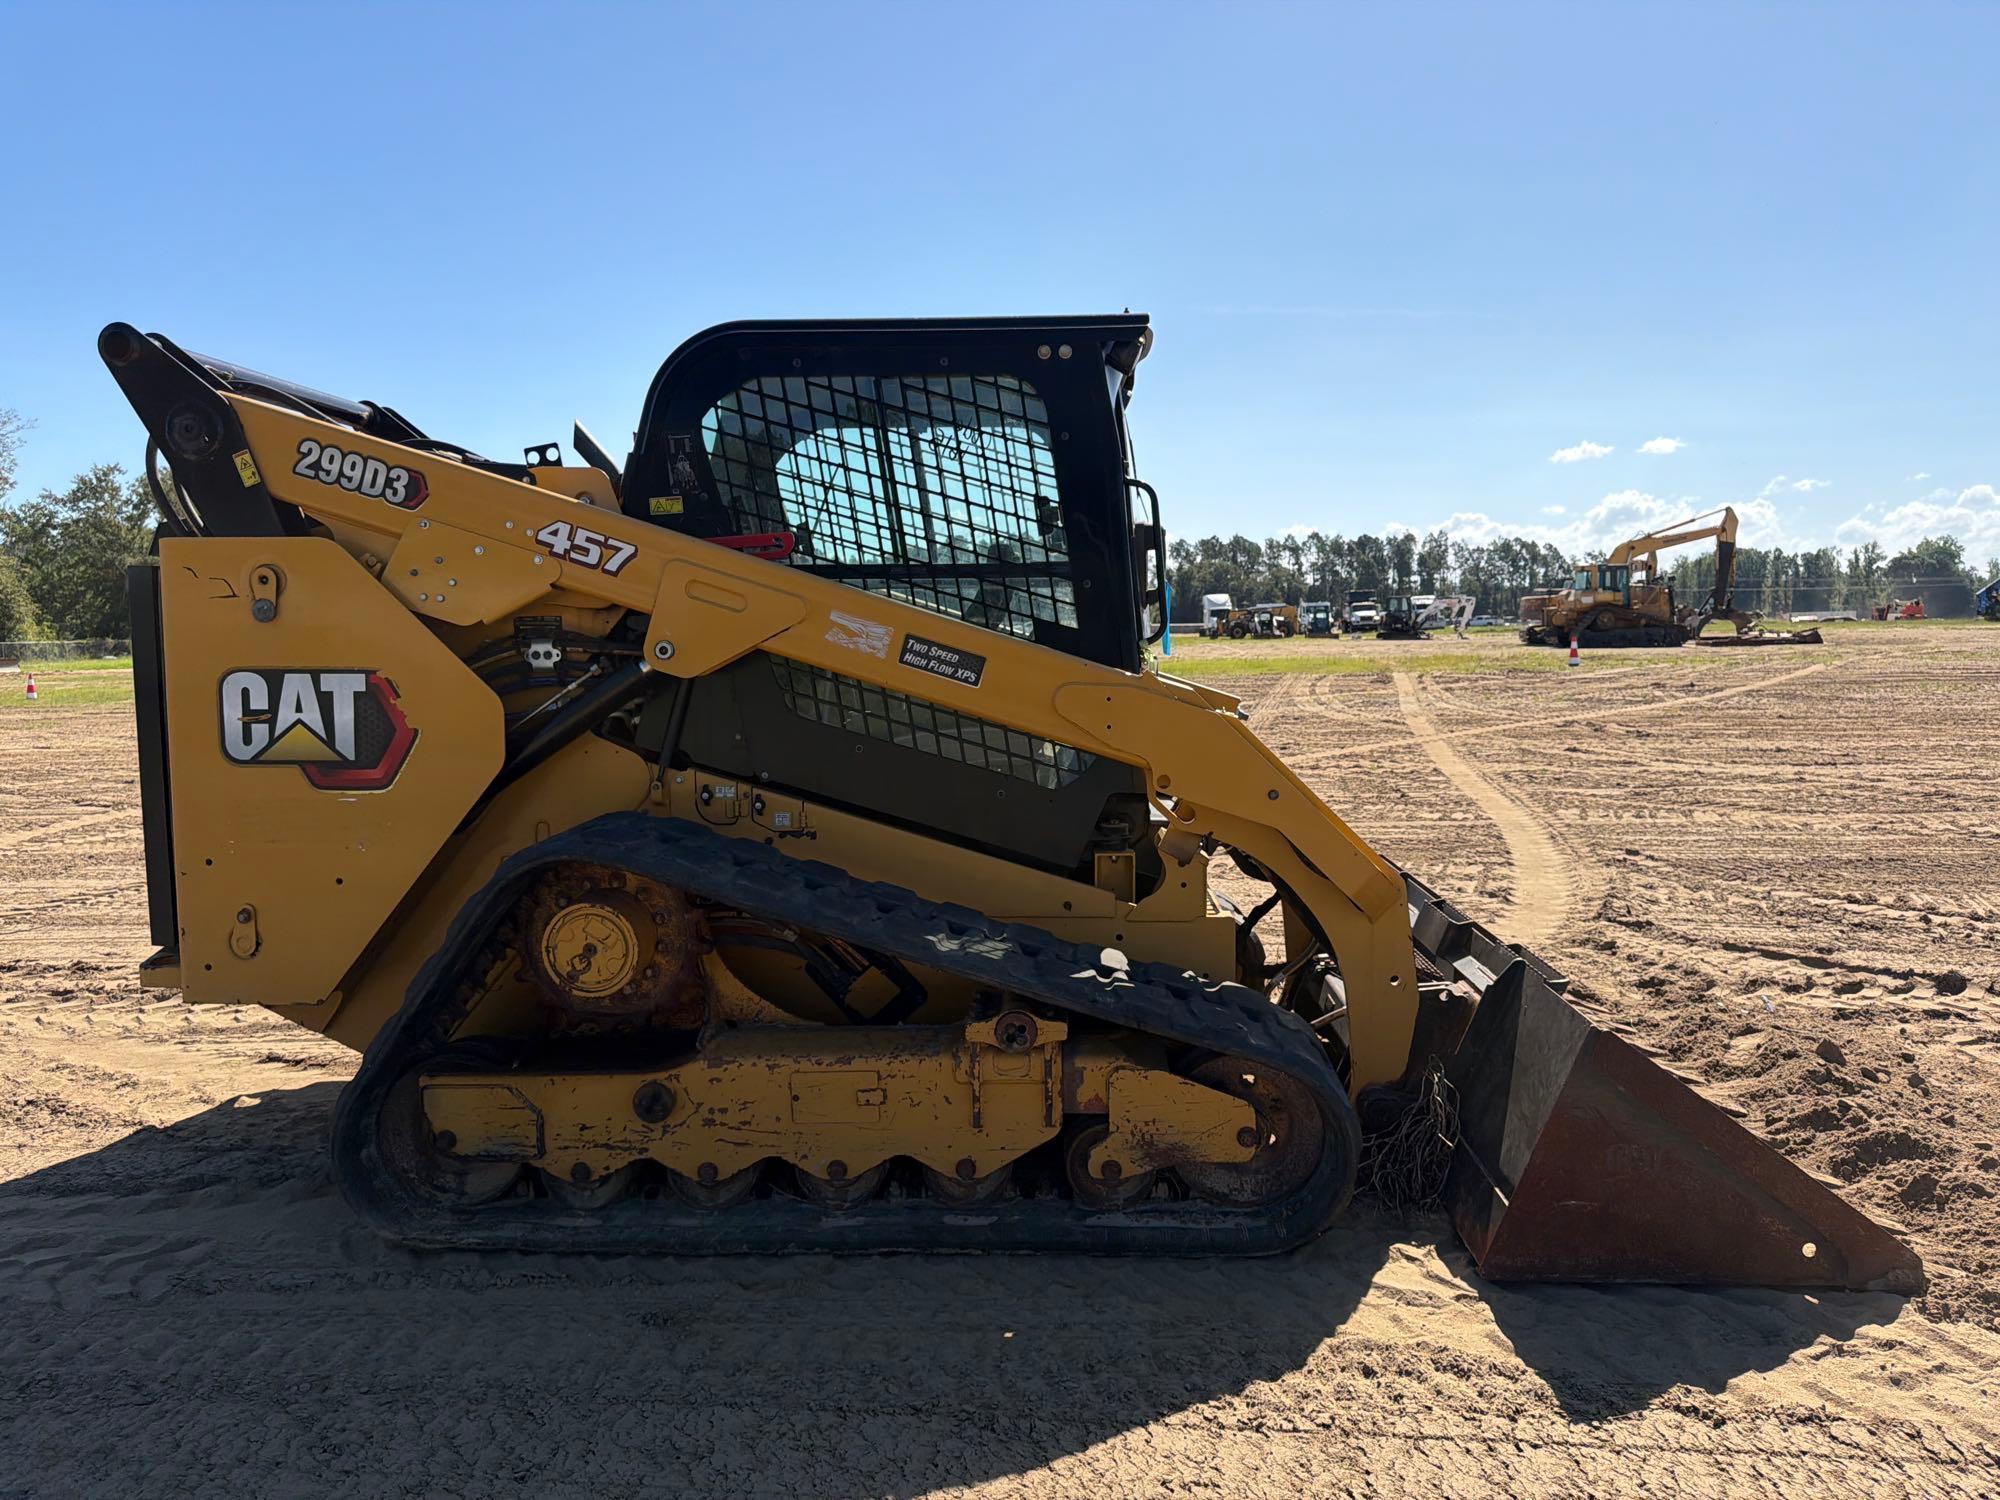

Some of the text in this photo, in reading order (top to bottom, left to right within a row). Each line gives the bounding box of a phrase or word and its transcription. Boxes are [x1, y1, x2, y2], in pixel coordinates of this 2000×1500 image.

[293, 439, 410, 504] 299D3
[536, 520, 637, 576] 457
[903, 652, 978, 683] HIGH FLOW XPS
[929, 646, 959, 663] SPEED
[222, 671, 367, 761] CAT
